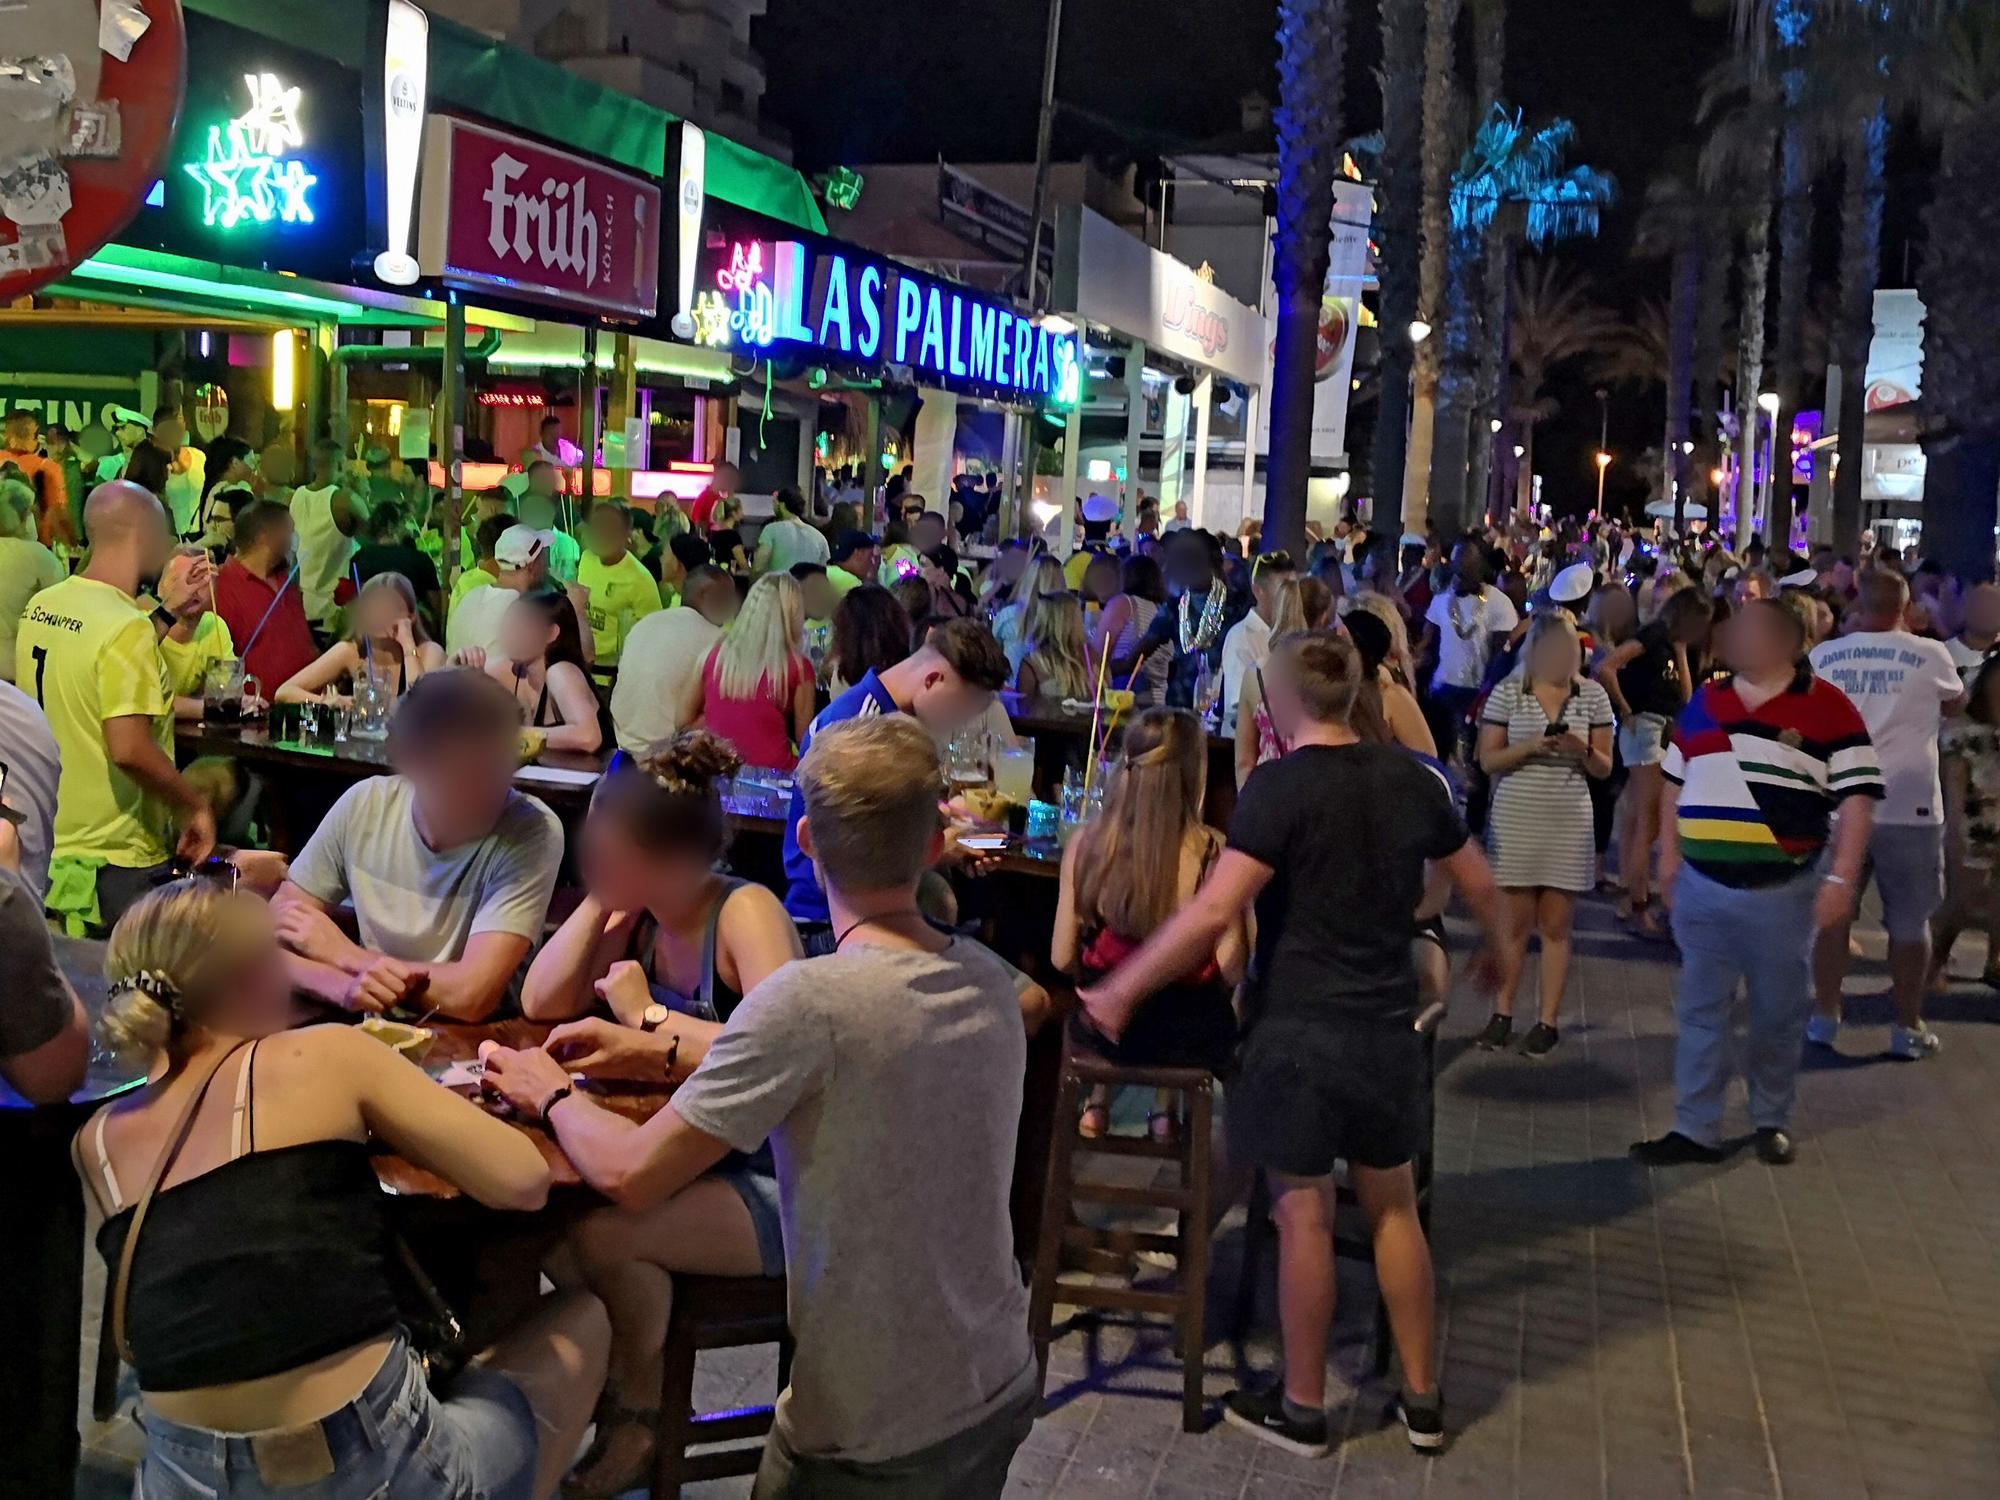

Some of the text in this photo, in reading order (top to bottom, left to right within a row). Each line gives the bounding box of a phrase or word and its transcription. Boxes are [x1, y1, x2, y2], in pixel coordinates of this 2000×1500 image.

[482, 152, 598, 289] früh
[774, 240, 1069, 396] LAS PALMERAS
